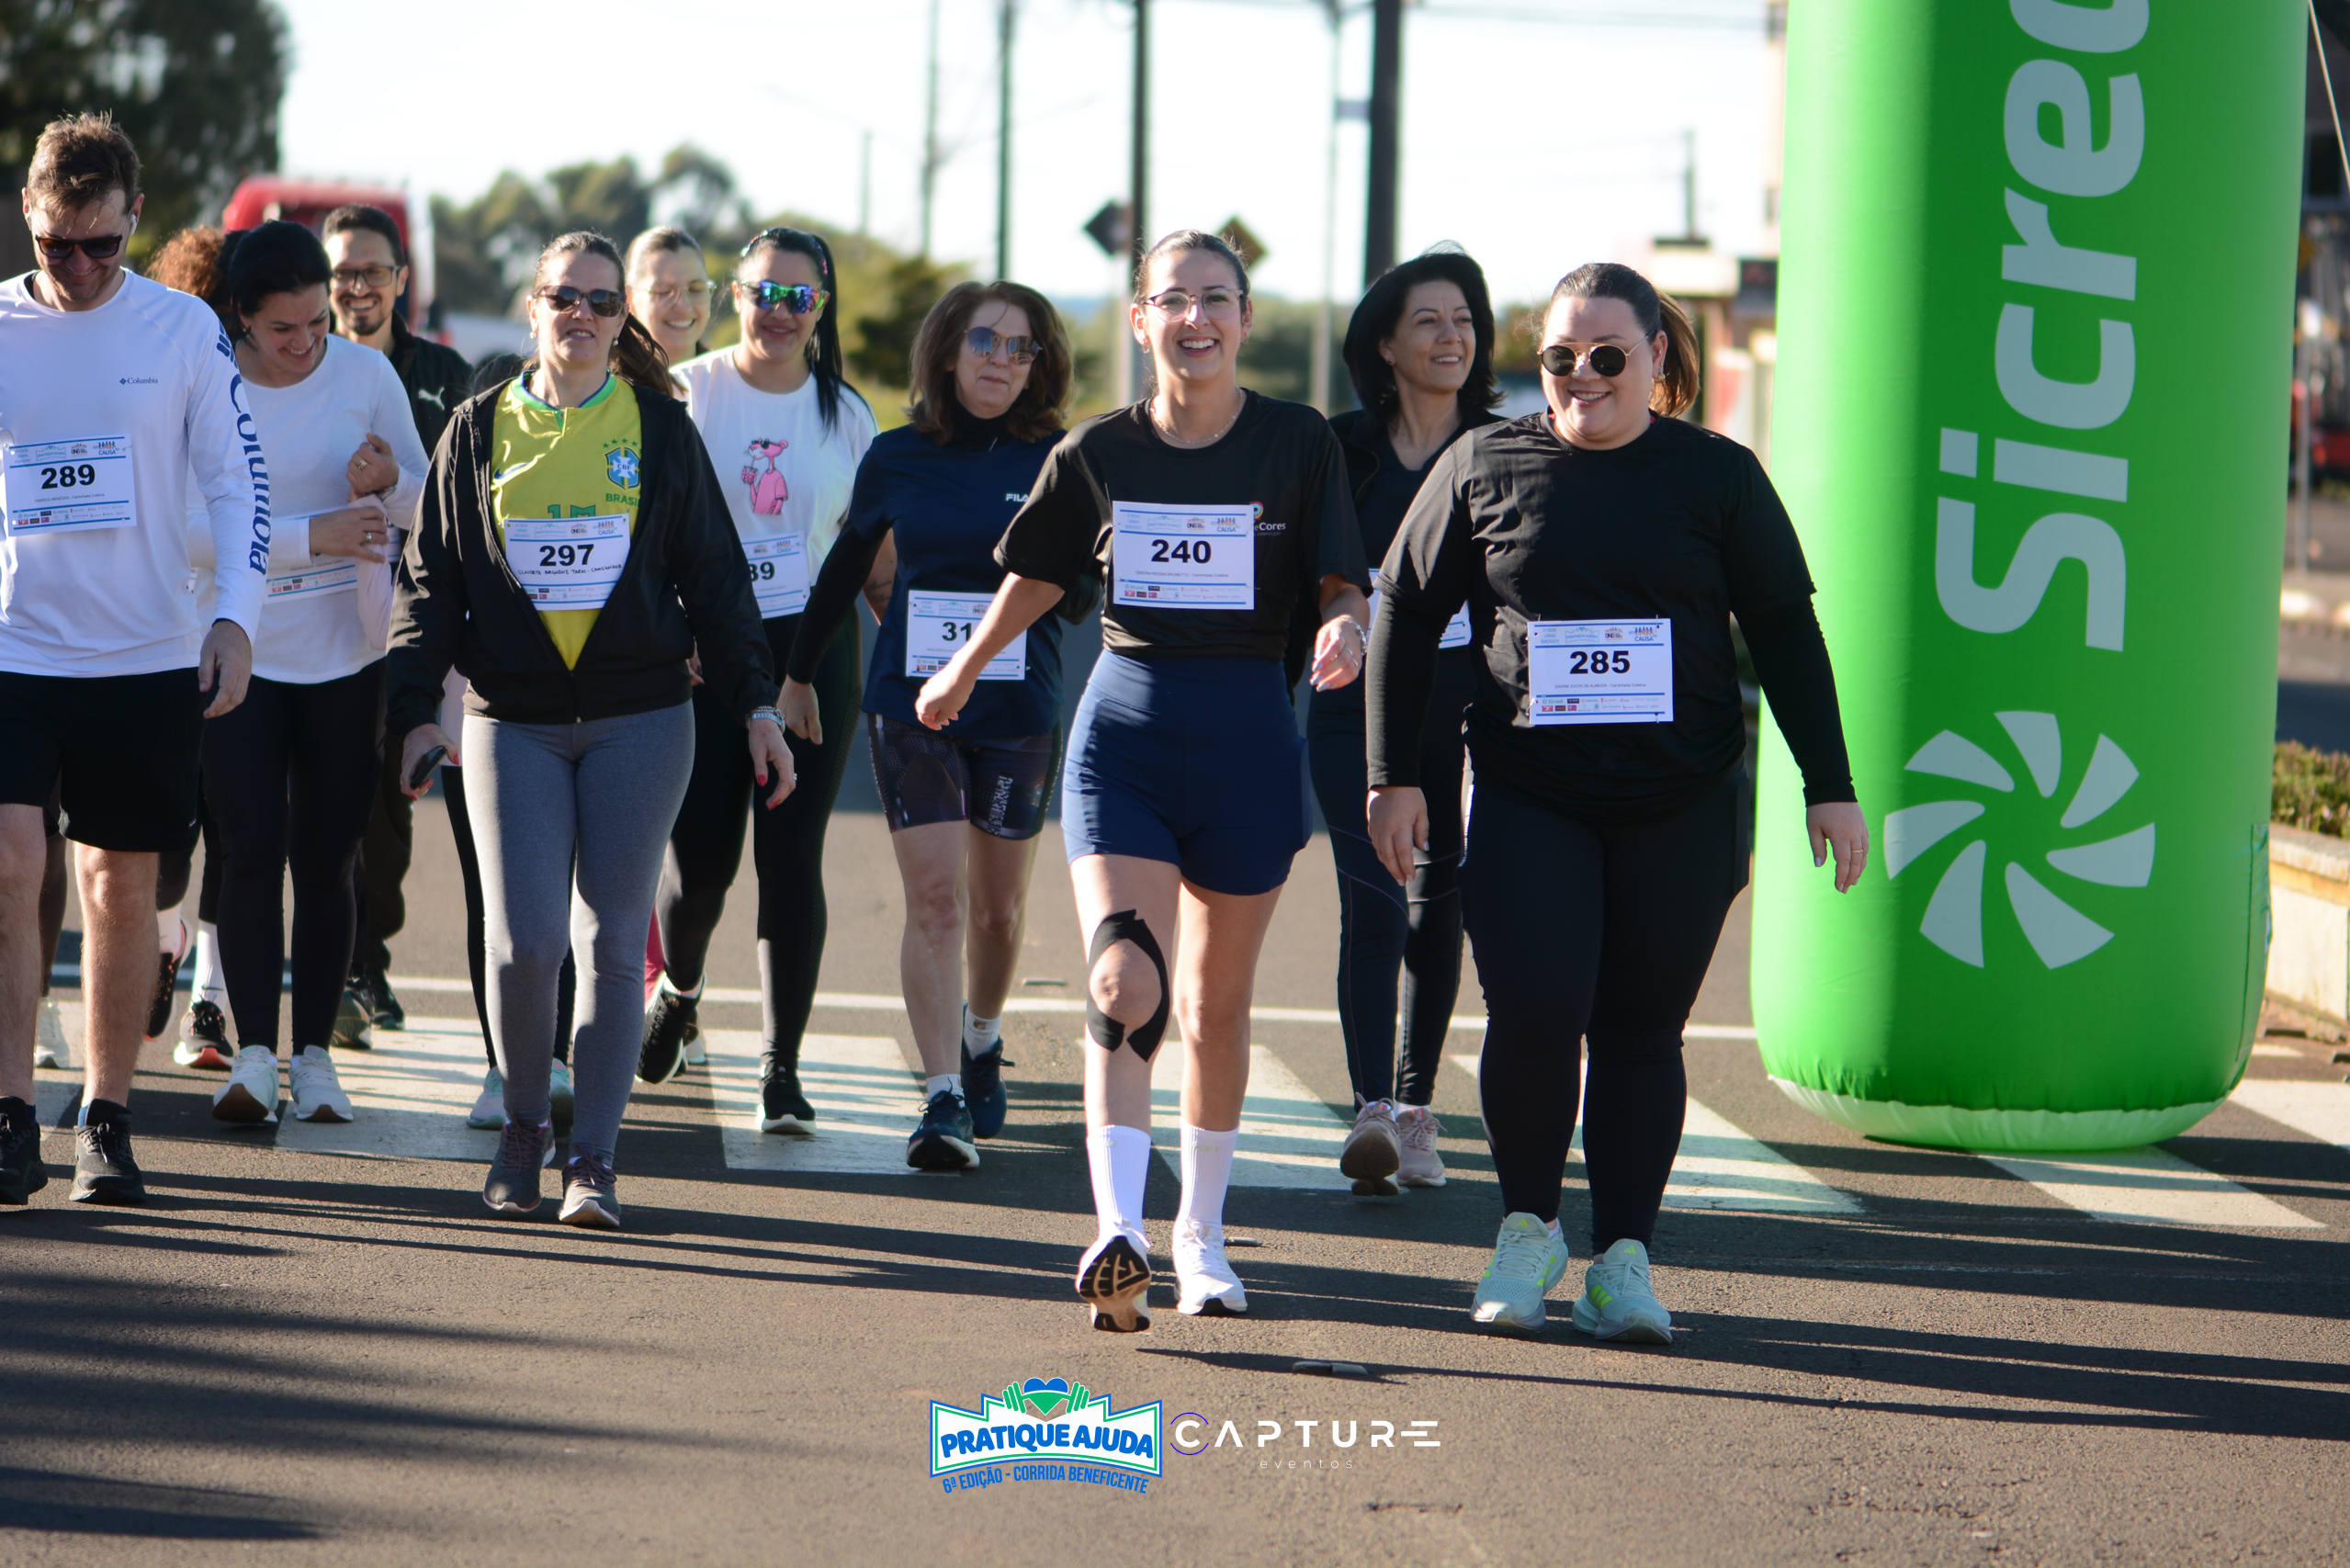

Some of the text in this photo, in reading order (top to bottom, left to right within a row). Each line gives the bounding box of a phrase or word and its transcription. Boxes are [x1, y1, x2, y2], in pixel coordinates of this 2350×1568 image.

[40, 463, 96, 490] 289
[1006, 493, 1029, 502] FILA
[539, 544, 594, 567] 297
[1151, 539, 1212, 564] 240
[1570, 650, 1631, 674] 285
